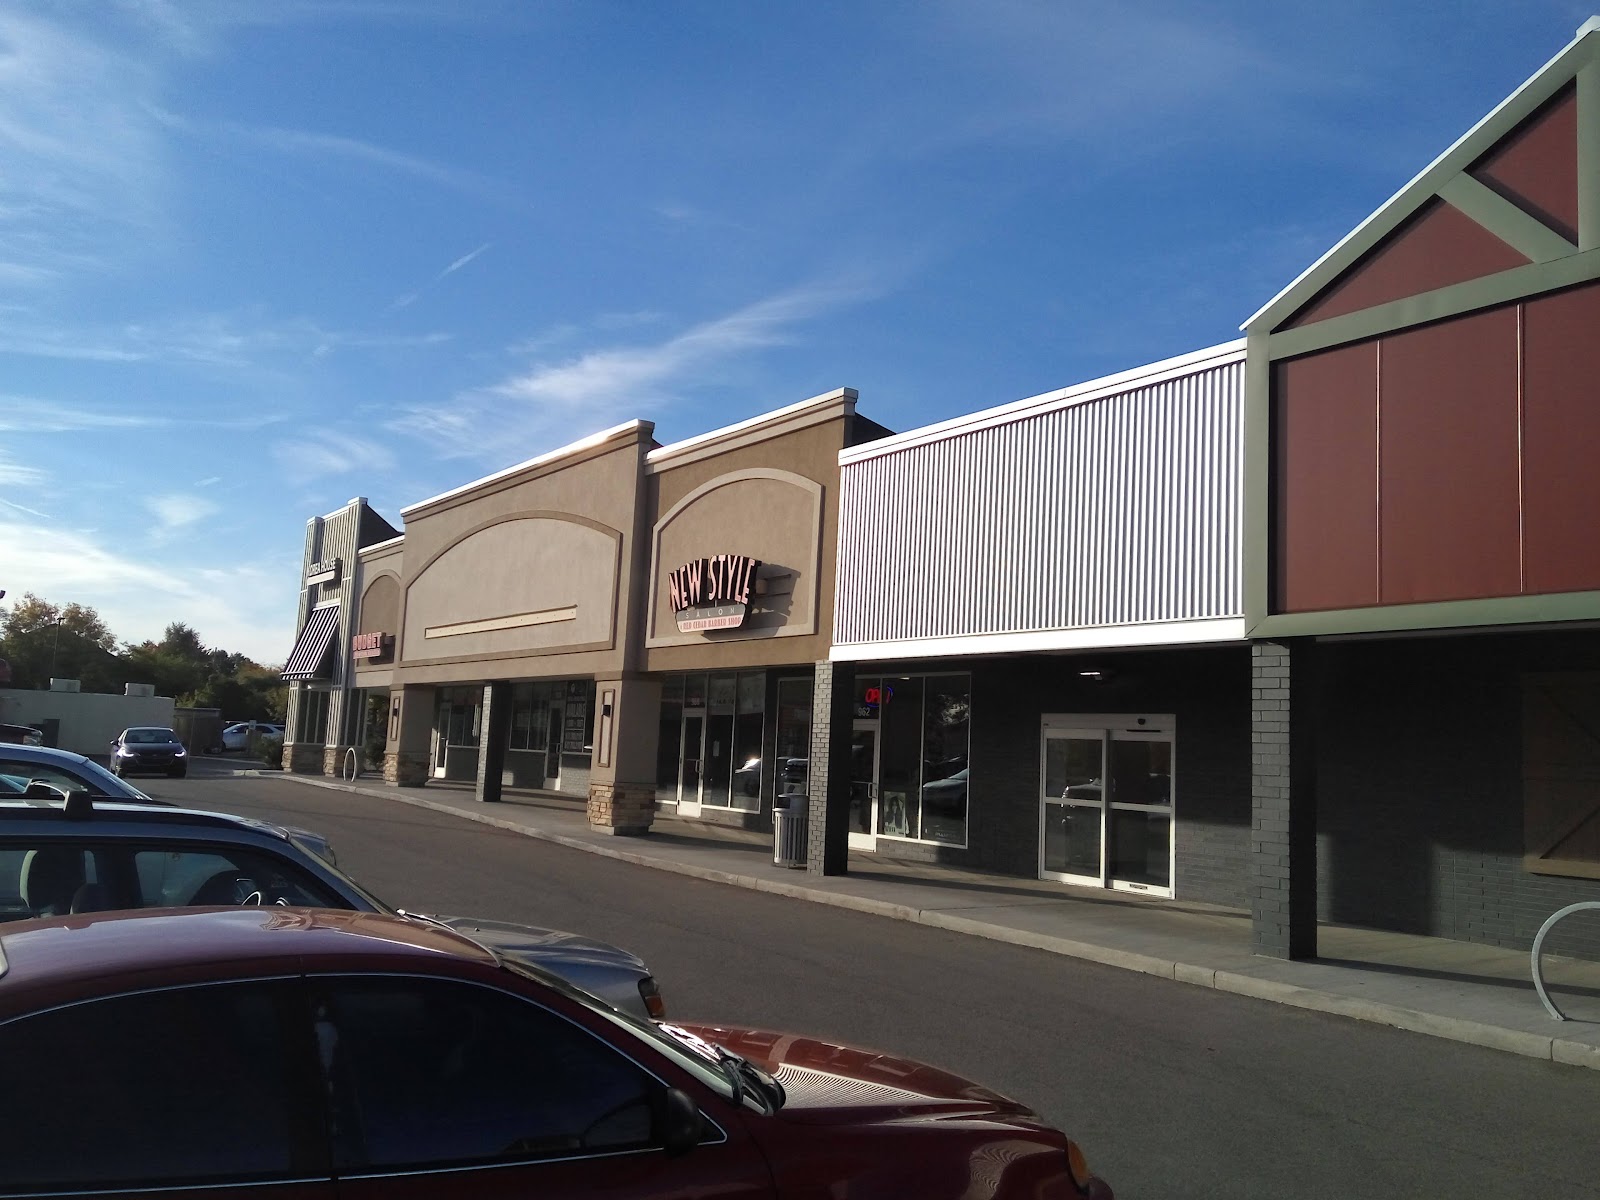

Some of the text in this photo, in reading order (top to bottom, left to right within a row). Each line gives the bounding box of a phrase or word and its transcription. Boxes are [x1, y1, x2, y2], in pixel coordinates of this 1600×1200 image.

[668, 554, 755, 613] NEW STYLE
[685, 607, 735, 619] SALON
[728, 616, 741, 626] SHOP
[352, 631, 382, 651] BUDGET
